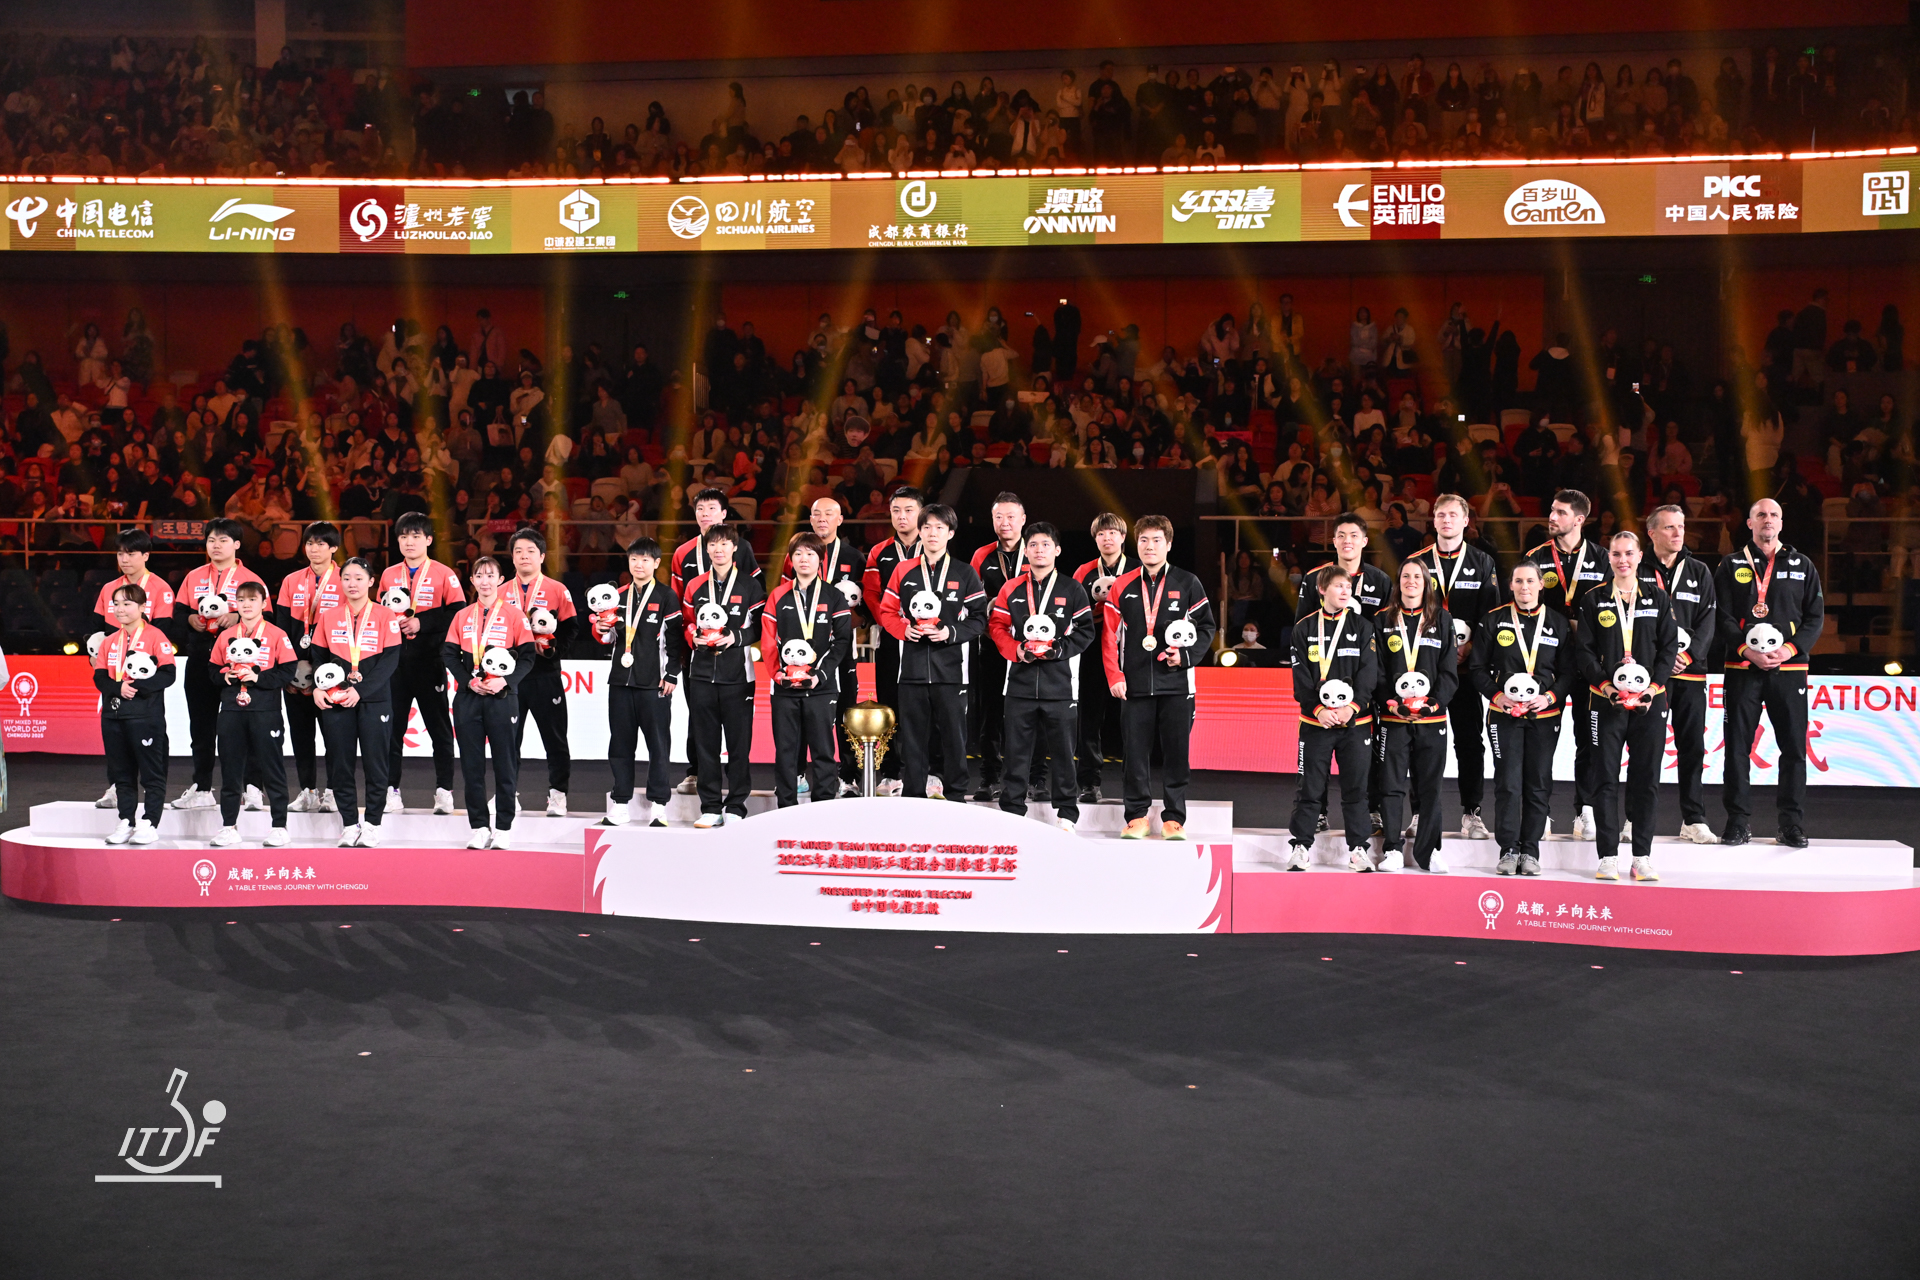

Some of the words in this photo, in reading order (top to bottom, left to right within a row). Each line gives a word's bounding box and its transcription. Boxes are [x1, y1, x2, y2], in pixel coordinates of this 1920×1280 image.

[1373, 184, 1446, 203] ENLIO
[1523, 187, 1577, 202] 百岁山
[1704, 175, 1761, 198] PICC
[1035, 187, 1105, 214] 澳悠
[1172, 186, 1275, 222] 红双喜
[56, 198, 154, 227] 中国电信
[715, 199, 815, 225] 四川航空
[1373, 203, 1446, 225] 英利奥
[1511, 201, 1596, 223] Ganten
[1665, 204, 1799, 223] 中国人民保险
[716, 224, 763, 235] SICHUAN
[766, 223, 815, 234] AIRLINES
[1215, 214, 1272, 229] DHS
[57, 229, 96, 239] CHINA
[98, 228, 154, 239] TELECOM
[208, 227, 296, 241] LI-NING
[394, 230, 494, 240] LUZHOULAOJIAO
[868, 223, 969, 241] 成都农商银行
[4, 725, 31, 733] WORLD
[32, 725, 47, 733] CUP
[1591, 710, 1599, 747] BUTTERFLY
[1490, 723, 1502, 759] BUTTERFLY
[776, 839, 798, 849] ITTF
[800, 840, 834, 850] MIXED
[837, 841, 866, 852] TEAM
[868, 842, 907, 853] WORLD
[910, 843, 932, 853] CUP
[935, 844, 989, 854] CHENGDU
[993, 845, 1018, 855] 2025
[819, 886, 873, 897] PRESENTED
[876, 888, 889, 897] BY
[891, 889, 923, 898] CHINA
[925, 890, 973, 899] TELECOM
[1524, 920, 1547, 928] TABLE
[1548, 921, 1575, 930] TENNIS
[1576, 923, 1612, 933] JOURNEY
[1613, 926, 1633, 934] WITH
[1634, 927, 1673, 936] CHENGDU
